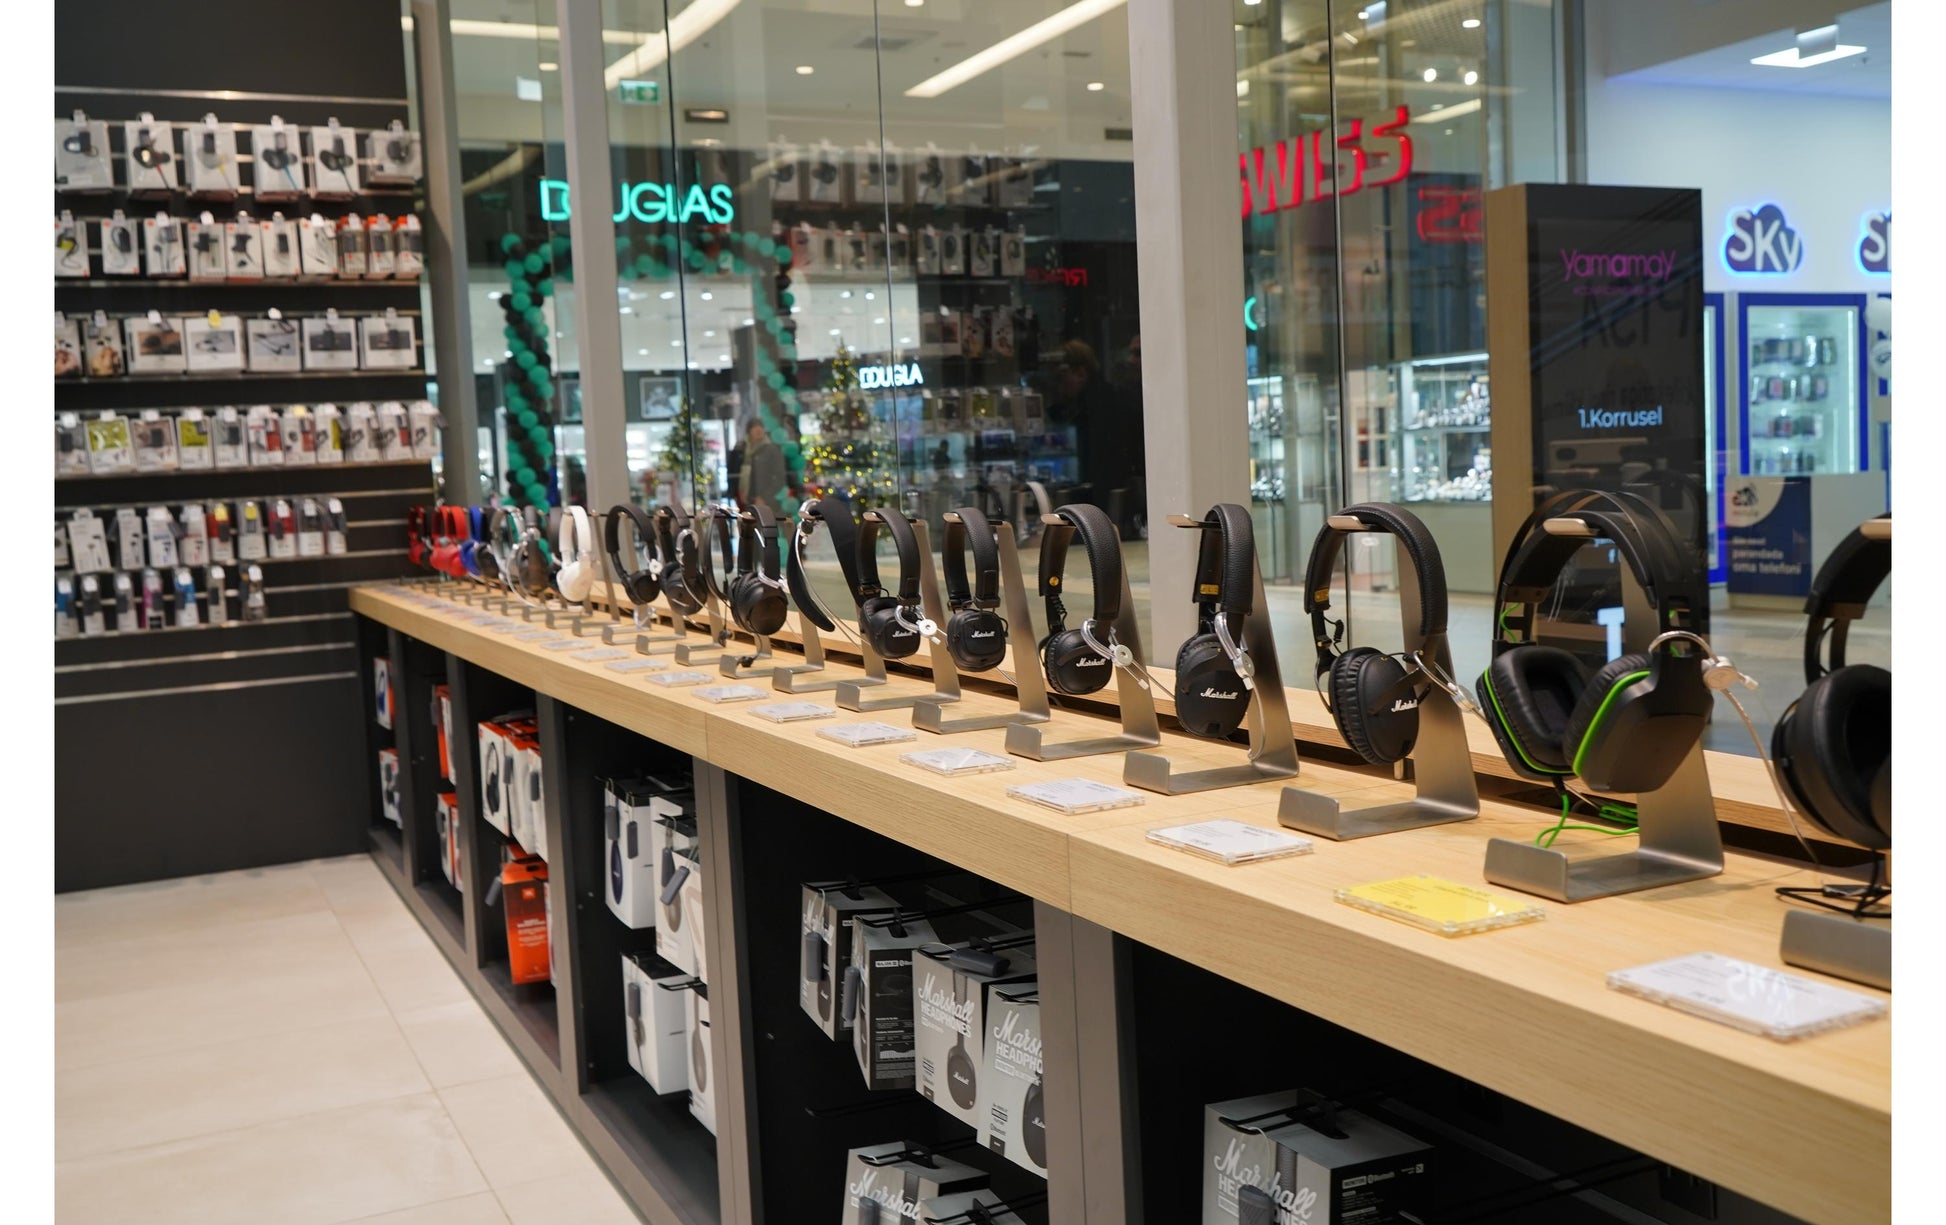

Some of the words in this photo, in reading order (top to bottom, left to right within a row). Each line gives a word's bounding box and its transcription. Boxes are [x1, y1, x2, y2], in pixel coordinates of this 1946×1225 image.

[540, 180, 734, 223] DUGLAS
[1863, 214, 1891, 271] S
[1200, 687, 1238, 699] Marshall
[918, 972, 974, 1024] Marshall
